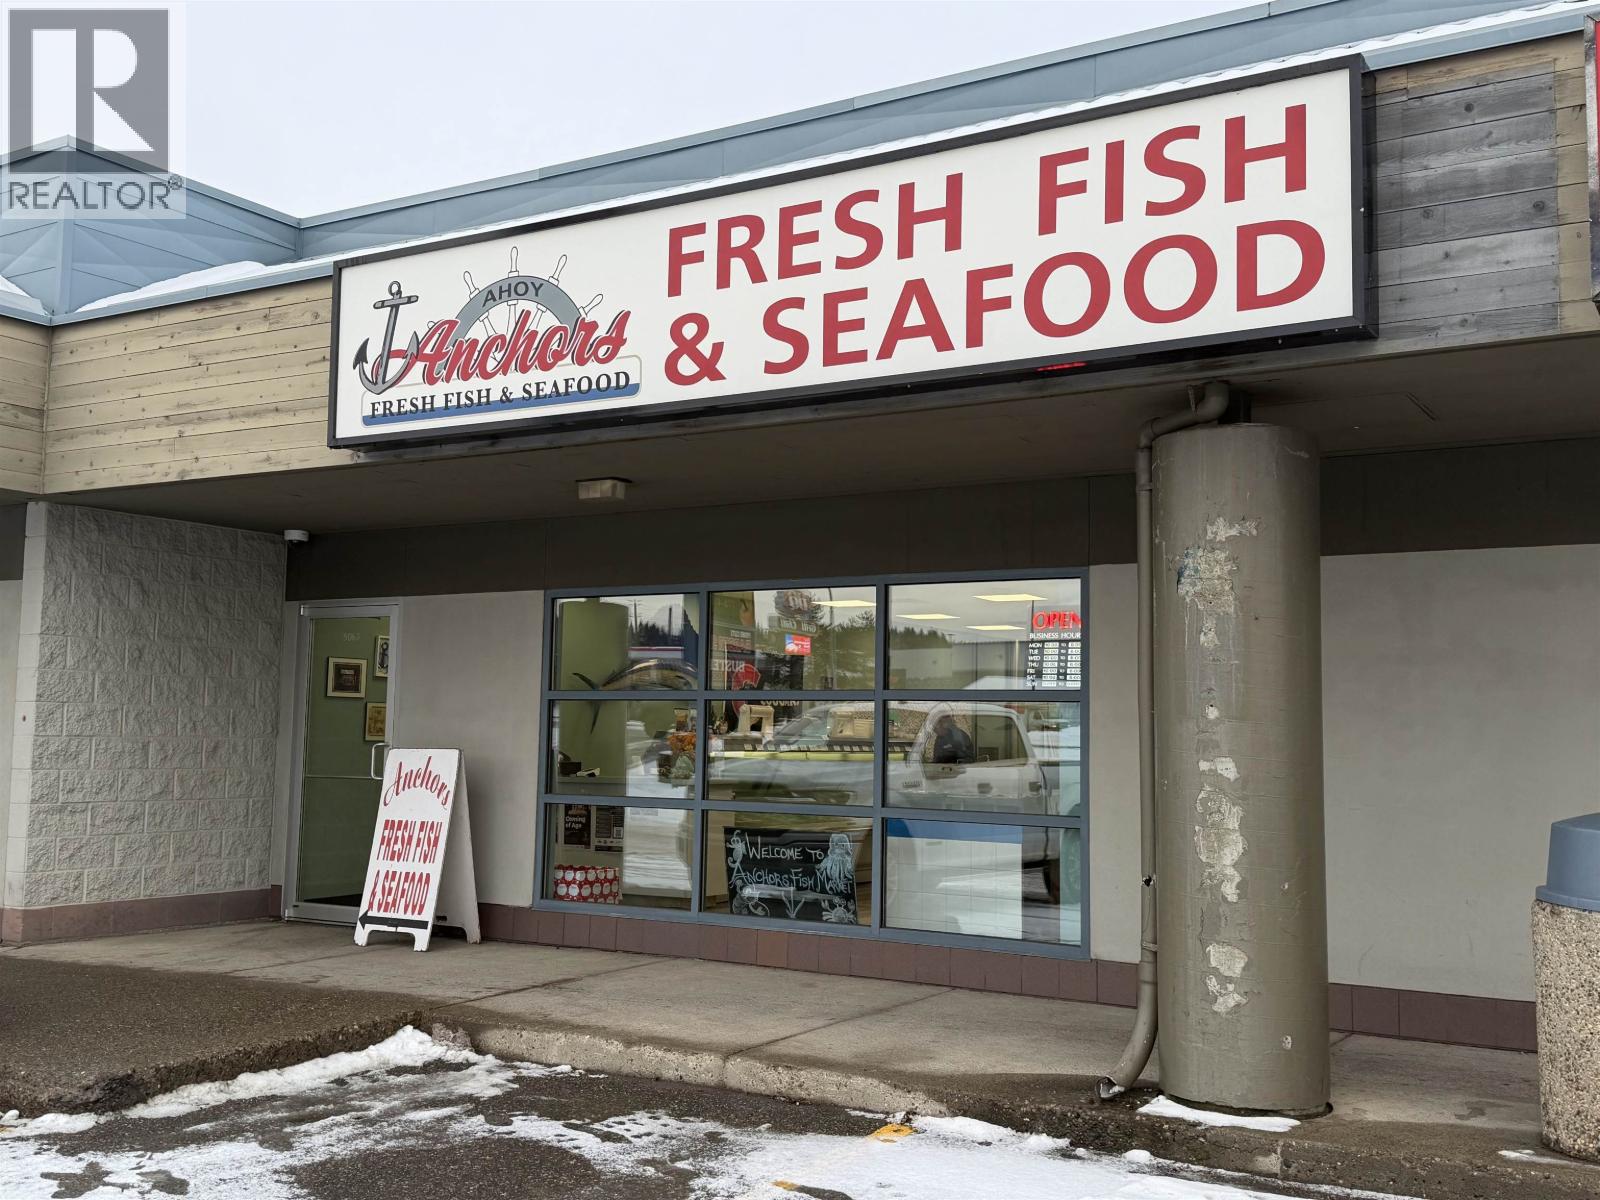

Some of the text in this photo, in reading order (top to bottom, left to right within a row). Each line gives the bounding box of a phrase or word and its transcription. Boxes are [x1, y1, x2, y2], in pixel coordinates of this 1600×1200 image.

[667, 103, 1307, 299] FRESH FISH
[482, 281, 545, 307] AHOY
[664, 219, 1325, 387] & SEAFOOD
[371, 309, 632, 386] Anchors
[370, 371, 631, 418] FRESH FISH & SEAFOOD
[1032, 610, 1081, 630] OPEN
[383, 756, 451, 811] Anchors
[376, 819, 443, 865] FRESH FISH
[367, 869, 431, 916] & SEAFOOD
